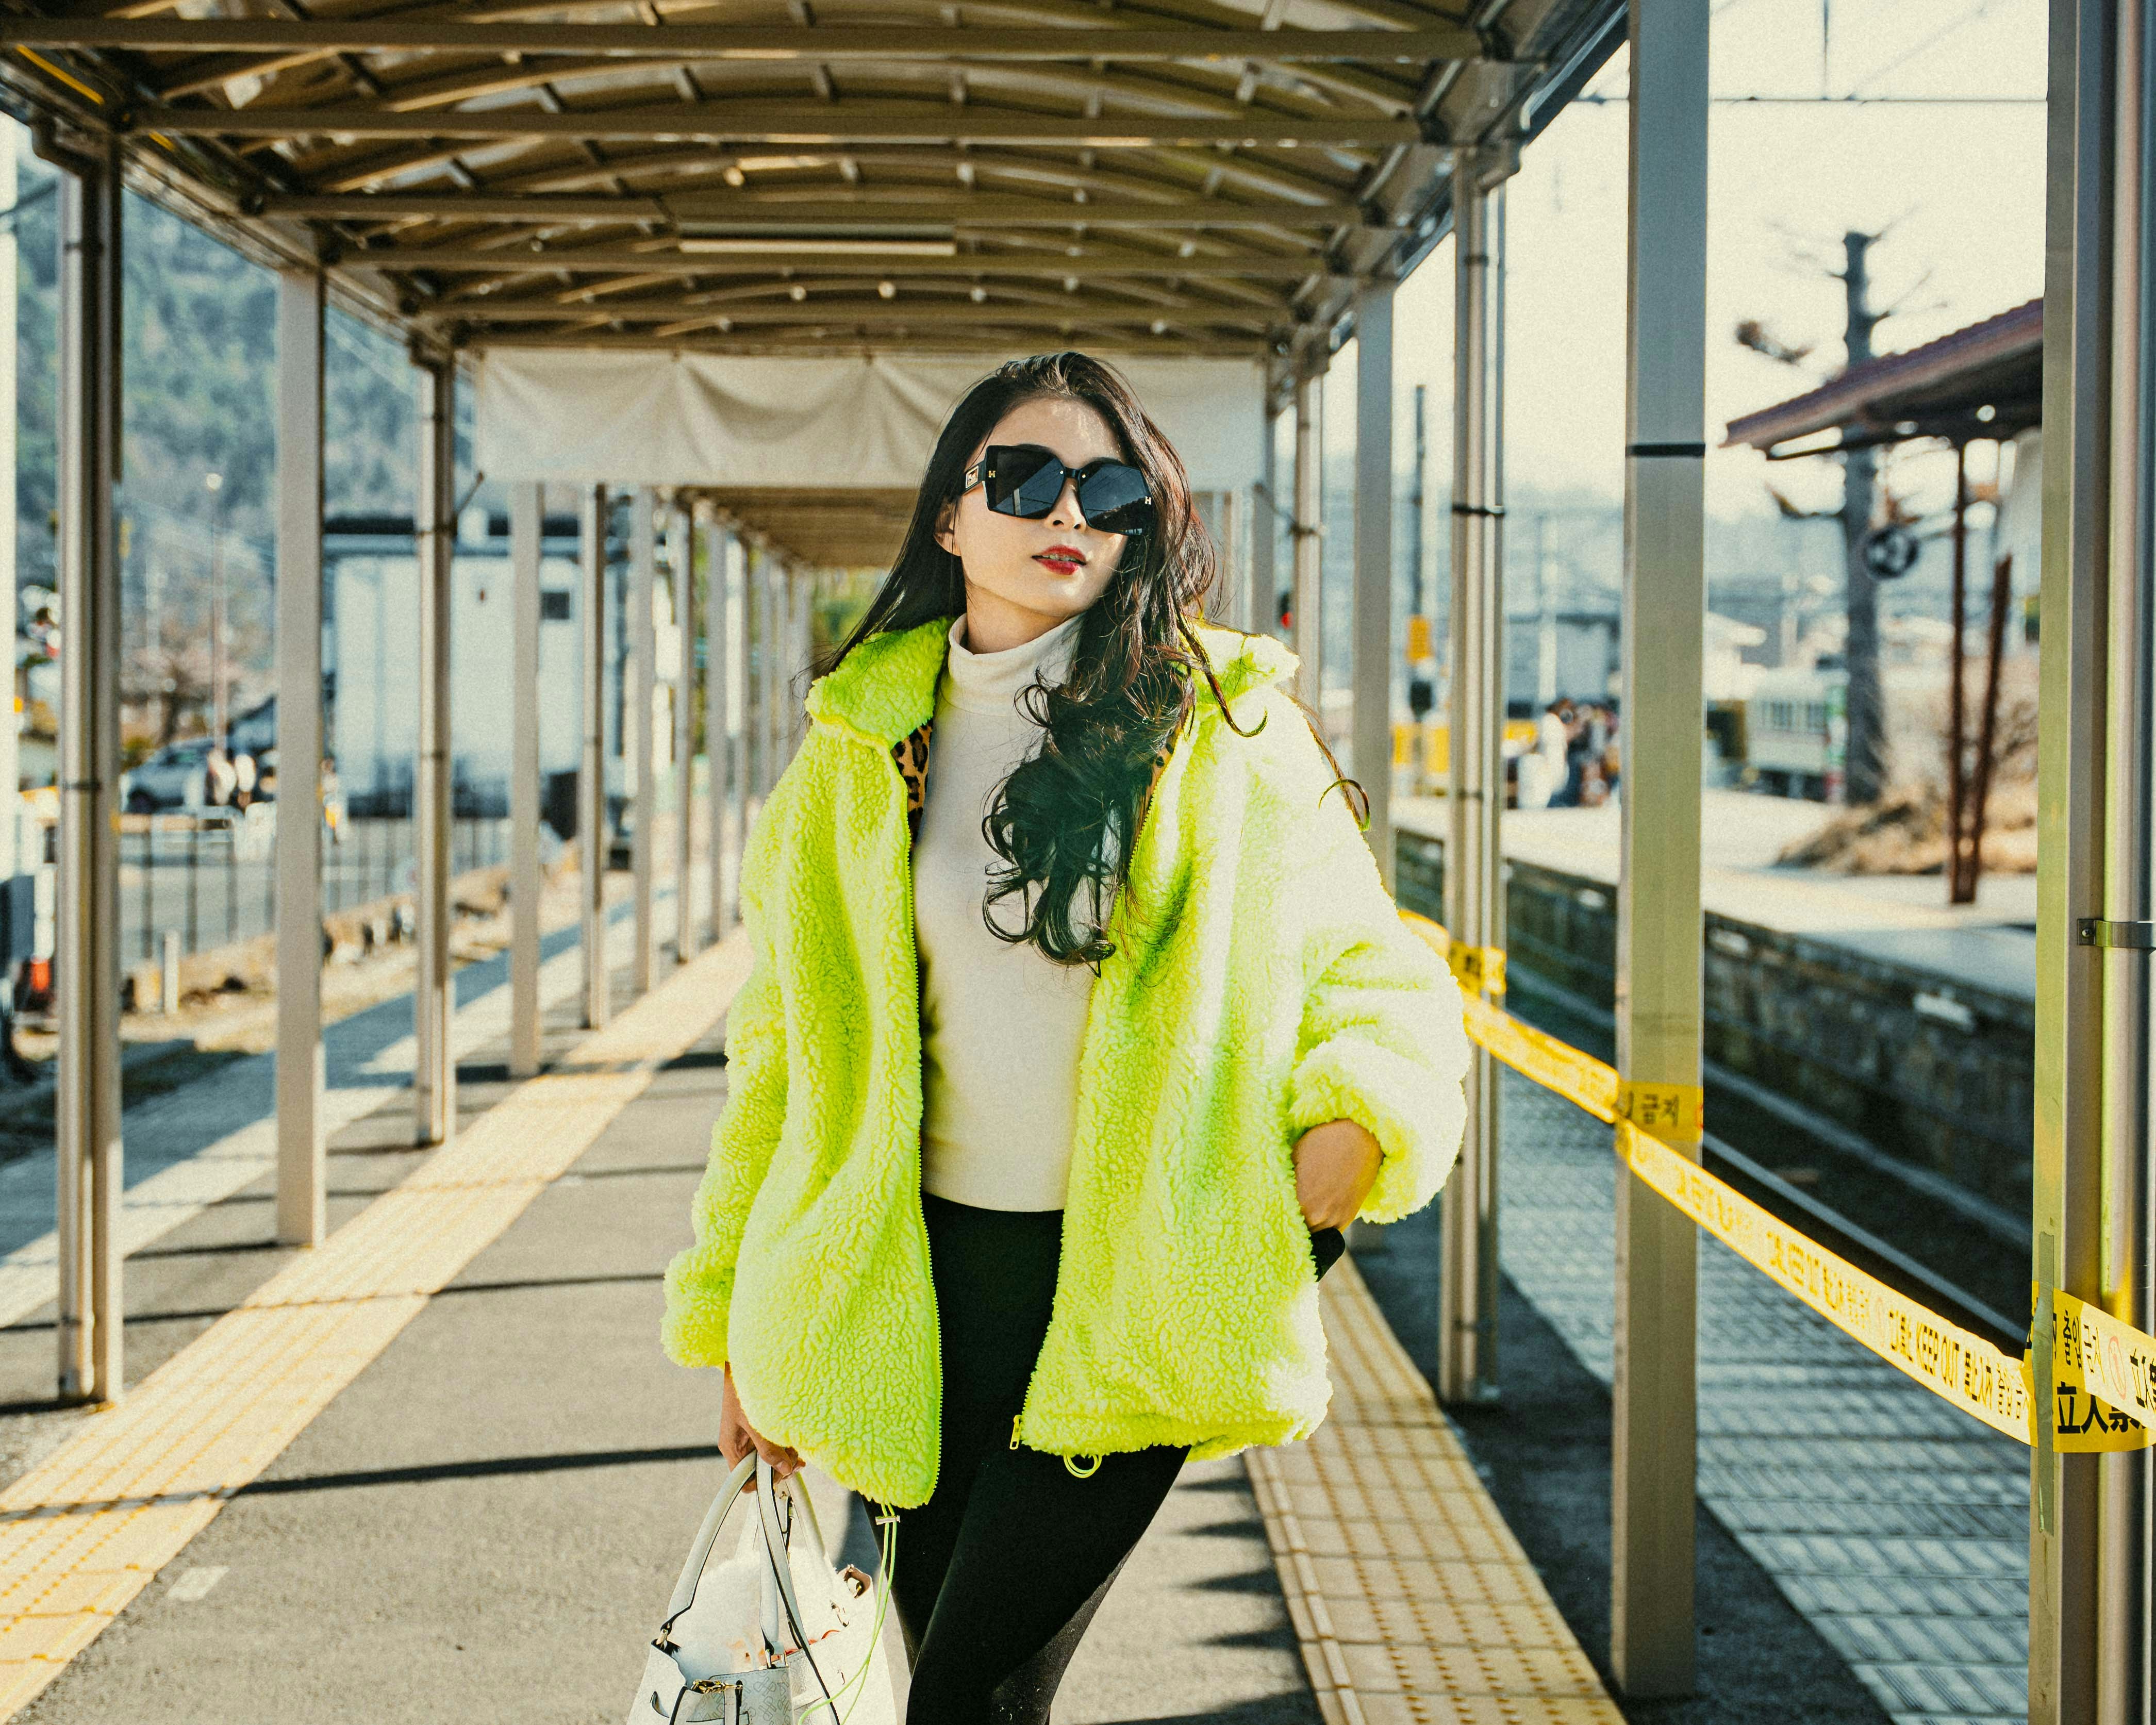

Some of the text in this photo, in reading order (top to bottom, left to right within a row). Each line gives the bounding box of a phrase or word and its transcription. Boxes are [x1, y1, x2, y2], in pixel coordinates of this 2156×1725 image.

[1916, 1321, 1939, 1376] KEEP
[1941, 1336, 1960, 1391] OUT
[2063, 1309, 2105, 1384] 출입금지
